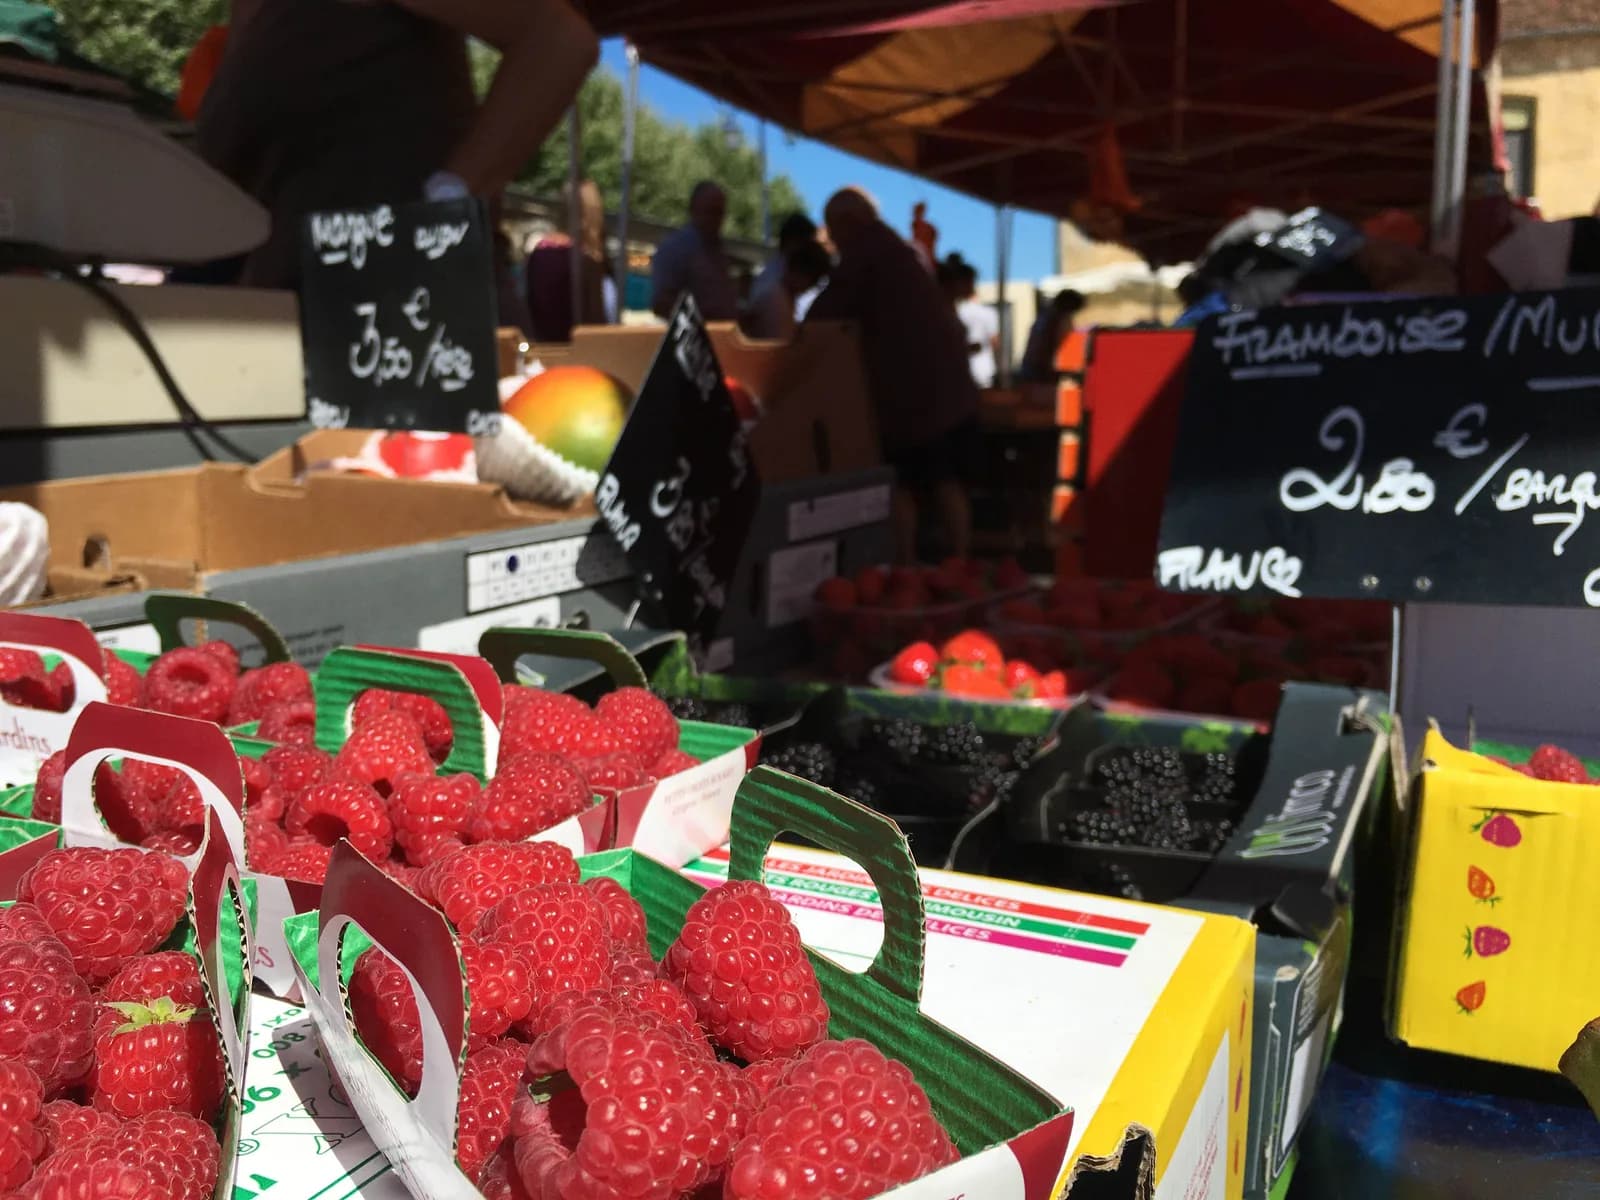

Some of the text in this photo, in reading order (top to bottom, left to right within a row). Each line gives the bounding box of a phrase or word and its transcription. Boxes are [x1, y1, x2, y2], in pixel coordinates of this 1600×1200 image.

[770, 890, 851, 915] ARDINS
[927, 919, 993, 940] LICES
[932, 886, 1021, 911] DELICES
